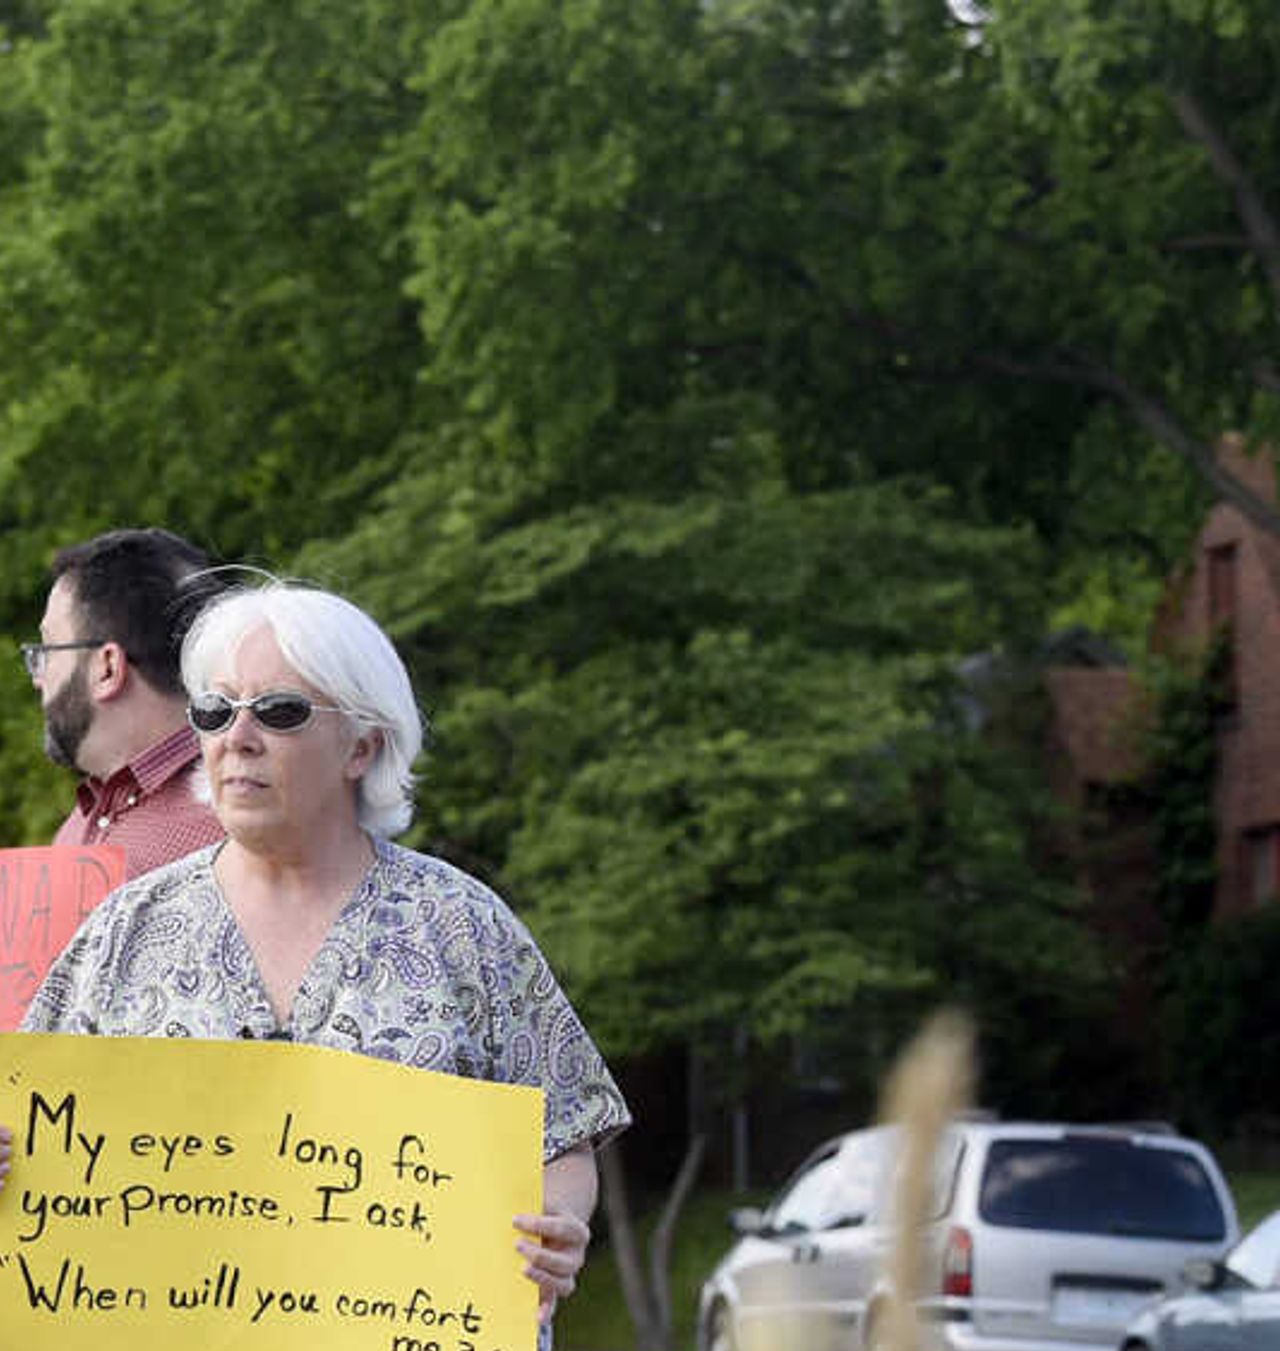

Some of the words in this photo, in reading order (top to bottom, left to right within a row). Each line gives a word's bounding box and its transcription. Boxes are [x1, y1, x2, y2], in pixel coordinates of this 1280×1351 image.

[130, 1134, 236, 1173] eyes
[278, 1112, 363, 1194] long
[391, 1134, 453, 1188] for
[18, 1190, 112, 1242] your
[311, 1186, 351, 1222] I
[168, 1263, 240, 1309] will
[251, 1287, 319, 1323] you
[336, 1287, 482, 1333] comfort
